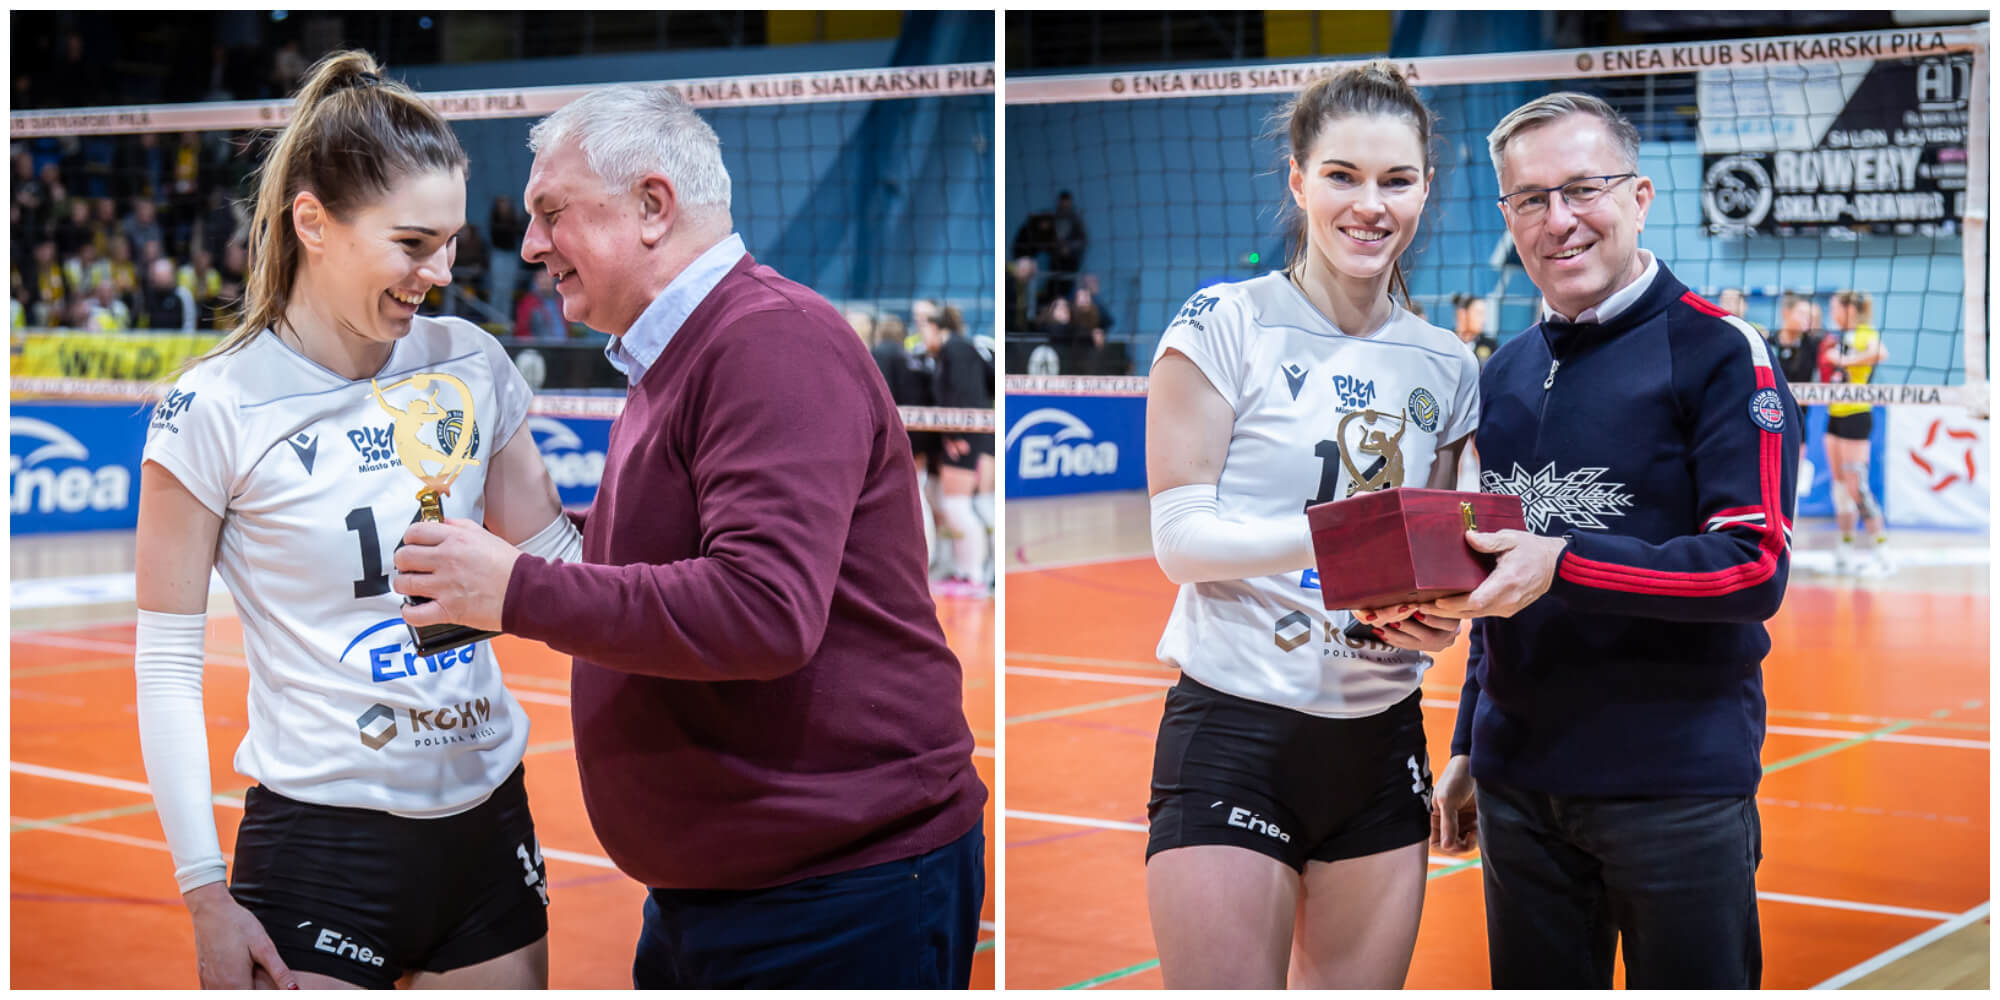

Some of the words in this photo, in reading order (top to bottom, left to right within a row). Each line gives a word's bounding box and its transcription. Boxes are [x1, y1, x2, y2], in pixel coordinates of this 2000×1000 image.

[1603, 50, 1664, 71] ENEA
[1673, 43, 1733, 66] KLUB
[1741, 34, 1882, 64] SIATKARSKI
[1891, 32, 1946, 53] PIŁA
[750, 79, 801, 98] KLUB
[811, 71, 939, 95] SIATKARSKI
[949, 69, 995, 88] PIŁA
[1133, 75, 1184, 93] ENEA
[1191, 71, 1241, 91] KLUB
[1773, 150, 1924, 192] ROWERY
[58, 345, 162, 380] WILD
[1341, 393, 1367, 408] 500
[1793, 386, 1893, 403] SIATKARSKI
[1900, 388, 1941, 405] PIŁA
[358, 462, 389, 473] Miasto
[362, 447, 391, 462] 500
[542, 452, 606, 488] nea
[1018, 435, 1119, 479] Enea
[10, 455, 131, 514] nea
[414, 735, 464, 747] POLSKA
[1228, 806, 1291, 843] Enea
[315, 928, 385, 967] Enea
